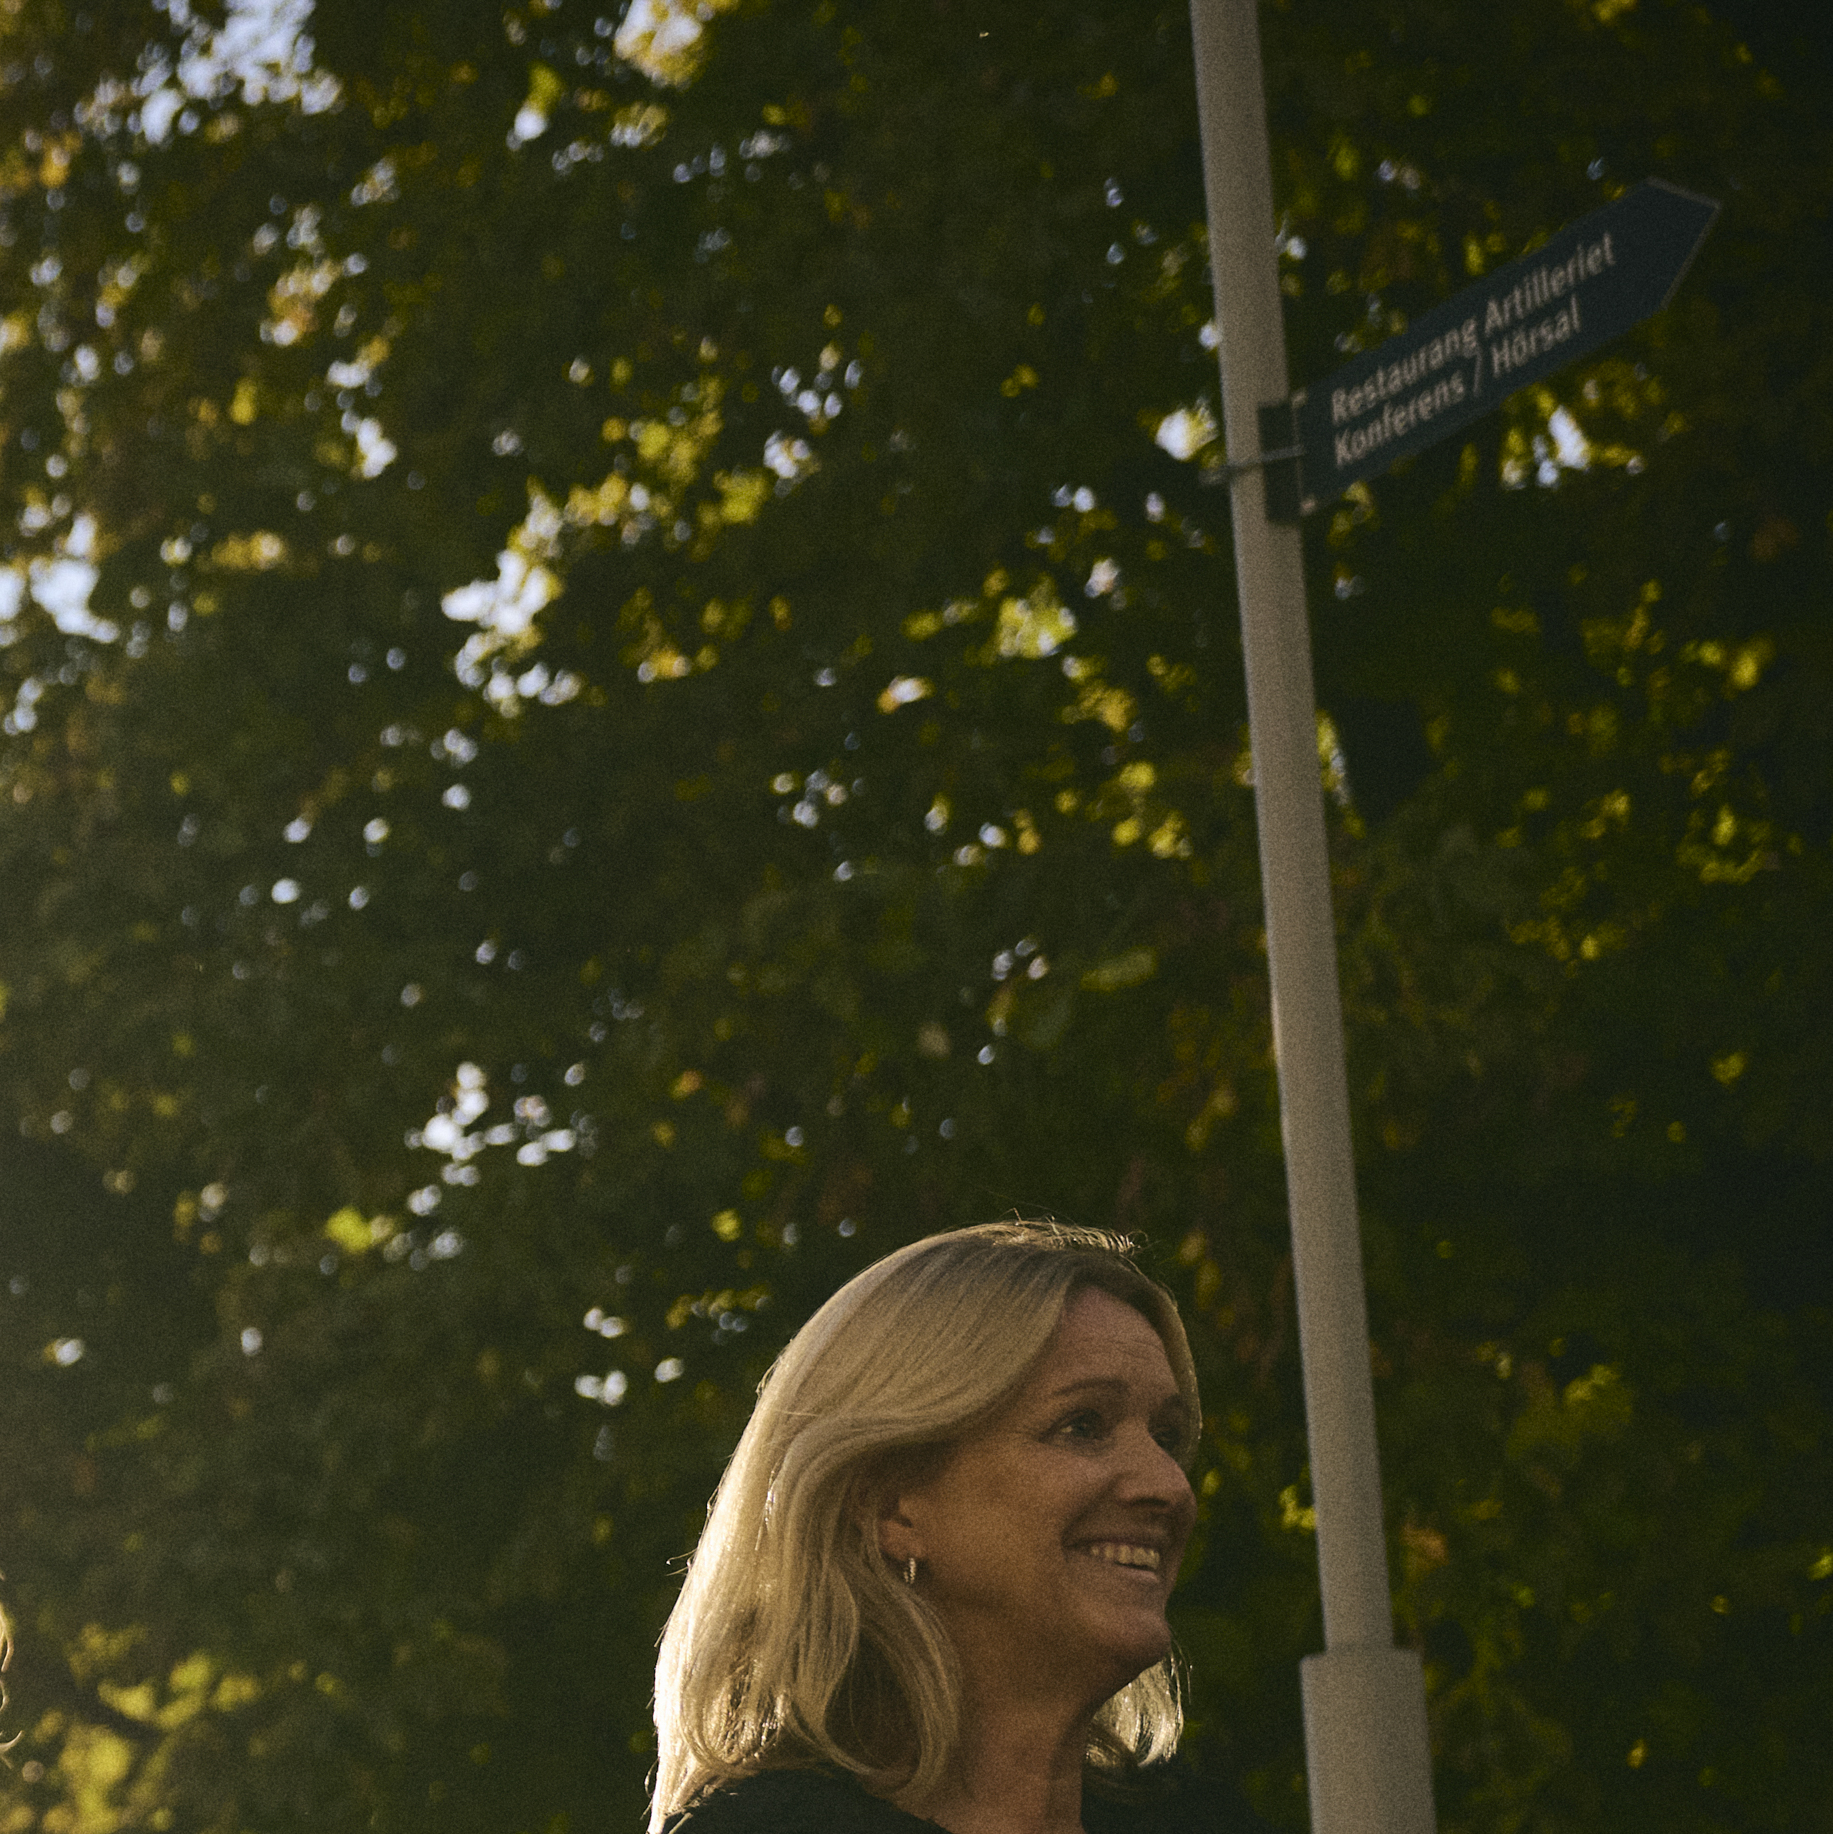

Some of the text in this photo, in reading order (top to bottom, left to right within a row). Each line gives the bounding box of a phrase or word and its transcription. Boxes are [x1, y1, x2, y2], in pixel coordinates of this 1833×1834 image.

[1332, 231, 1615, 423] Restaurang Artilleriet
[1335, 371, 1465, 468] Konferens
[1492, 294, 1581, 379] Hörsal
